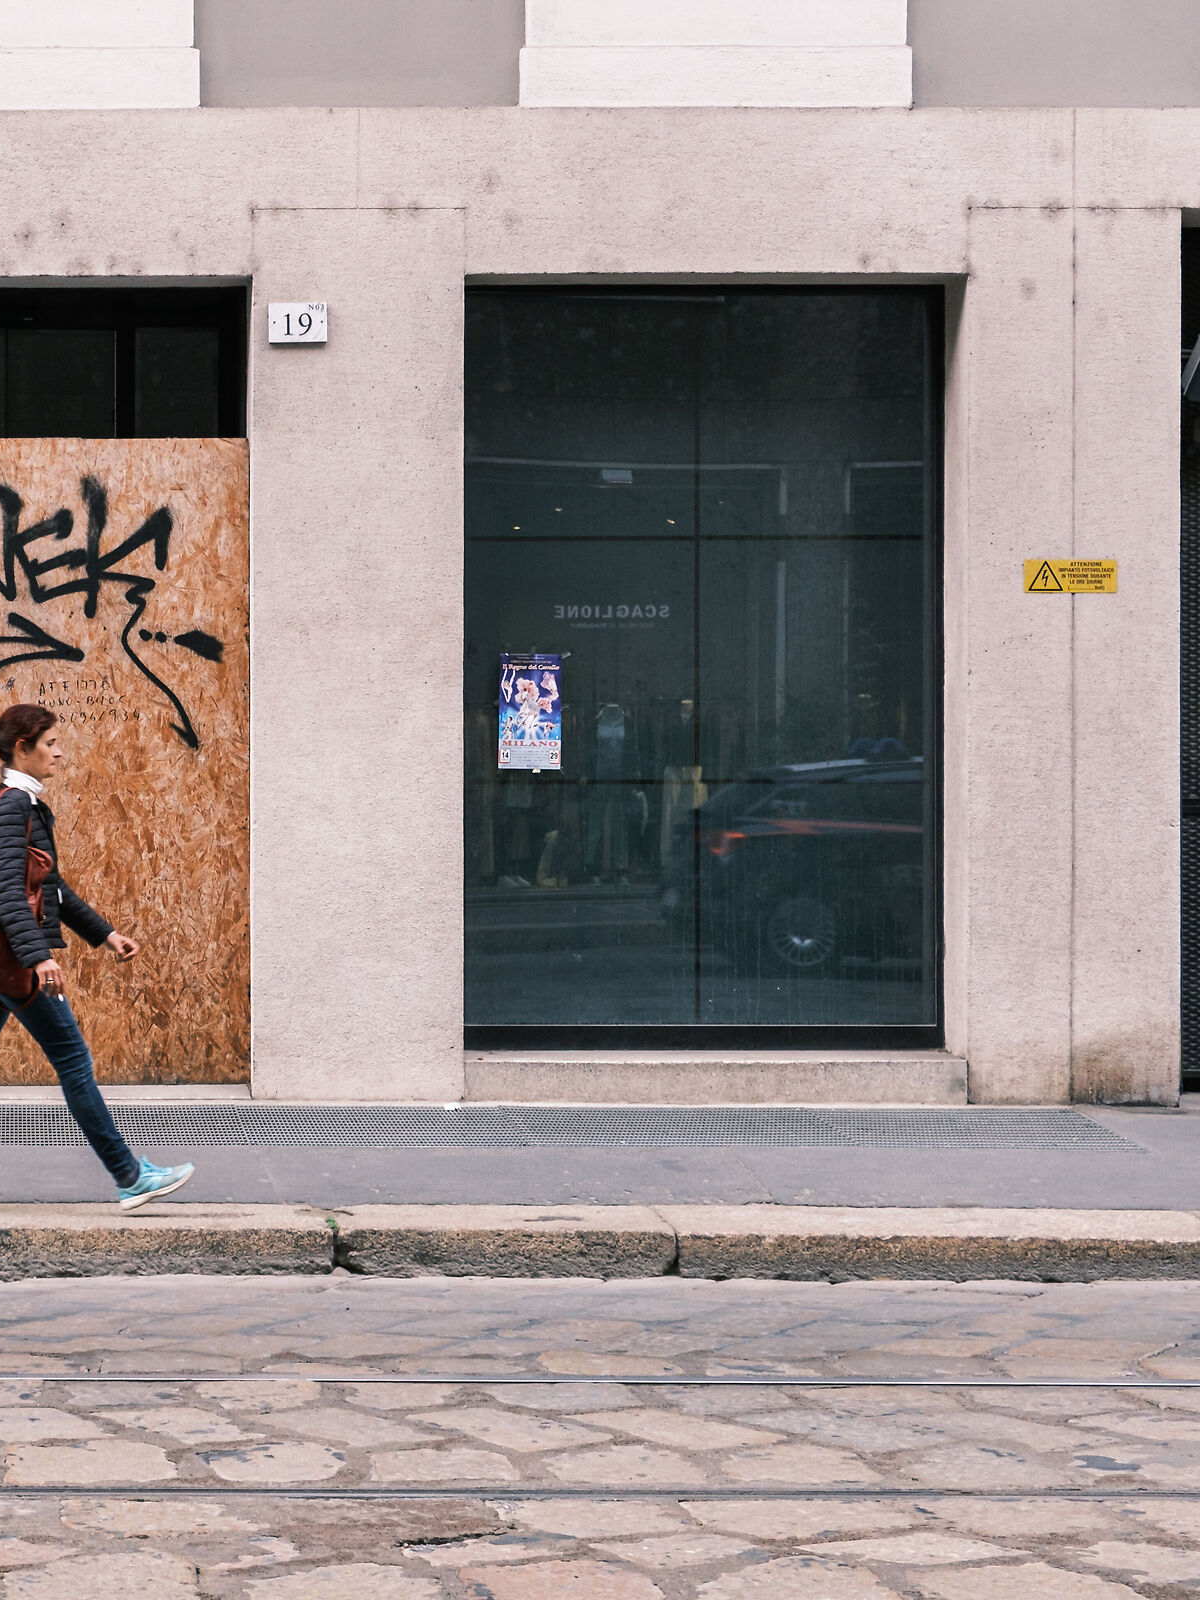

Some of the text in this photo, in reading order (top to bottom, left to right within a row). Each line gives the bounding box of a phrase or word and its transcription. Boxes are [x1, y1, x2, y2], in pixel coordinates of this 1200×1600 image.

[283, 313, 313, 336] 19
[501, 752, 509, 760] 14
[550, 752, 559, 760] 29
